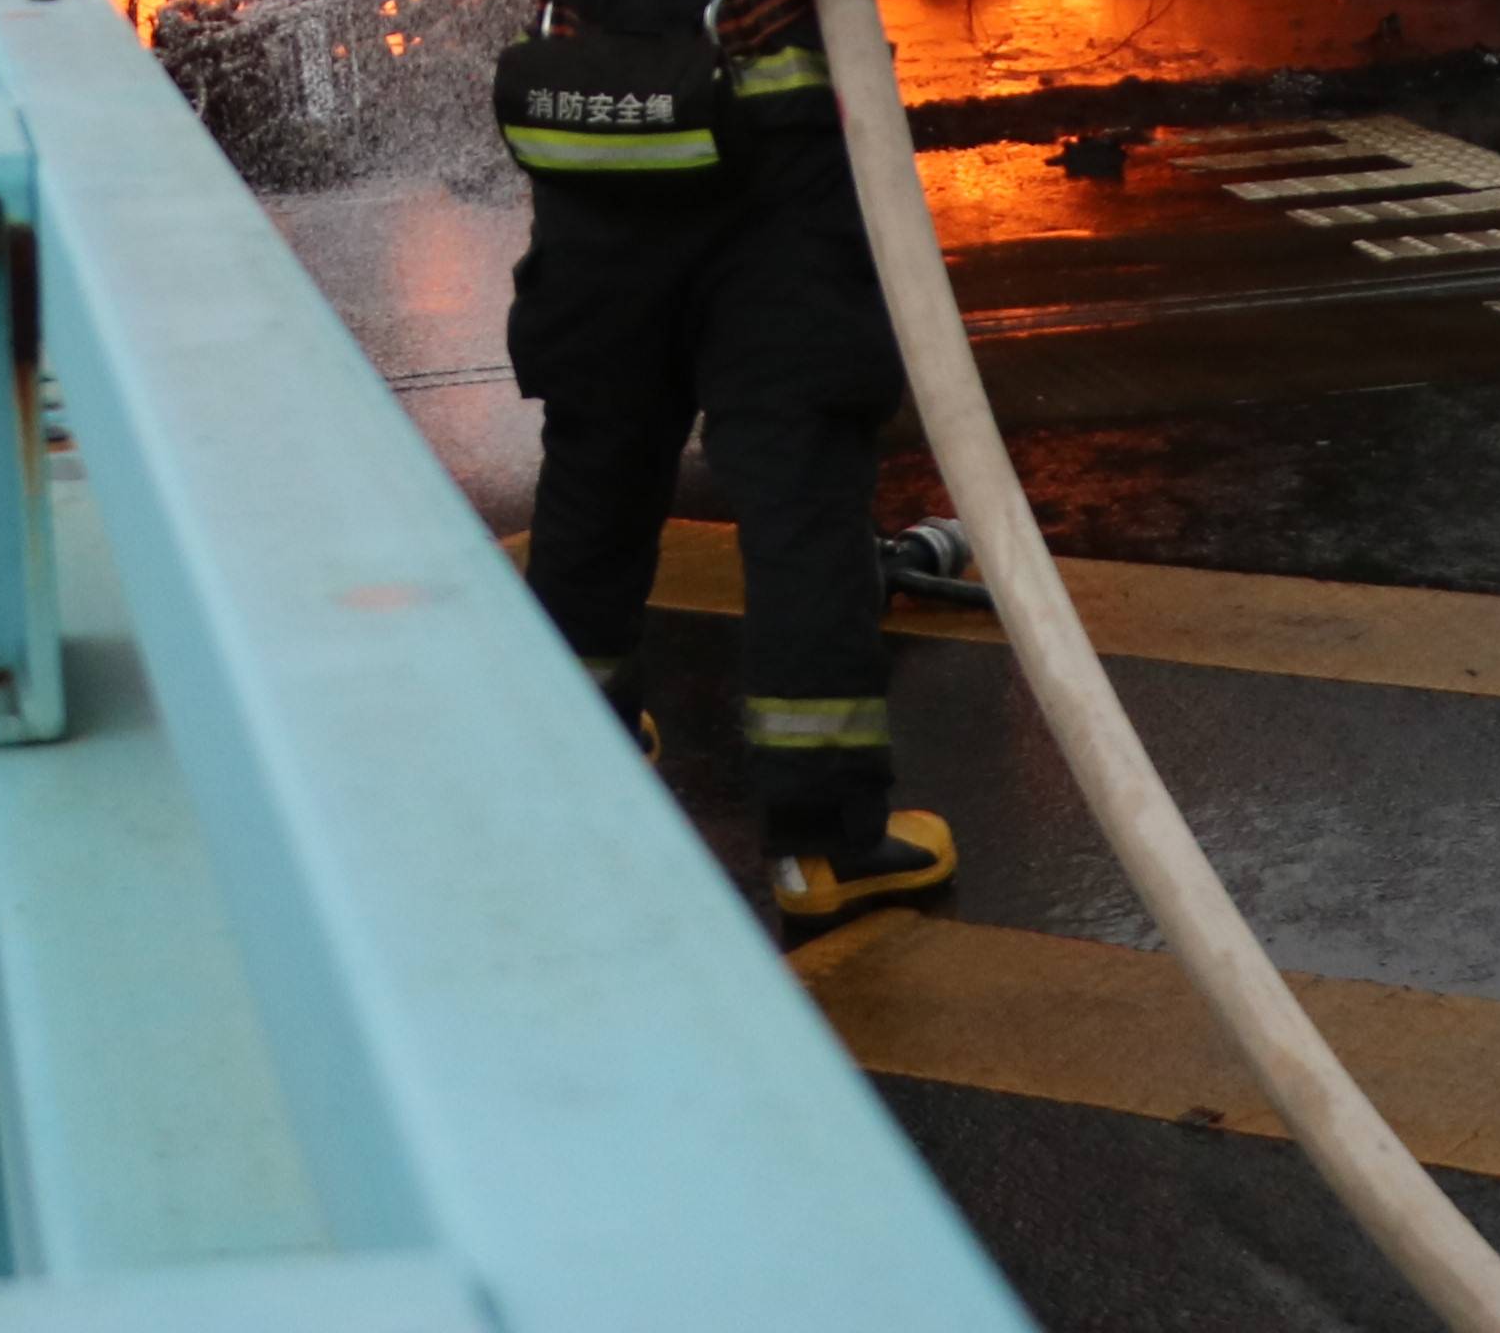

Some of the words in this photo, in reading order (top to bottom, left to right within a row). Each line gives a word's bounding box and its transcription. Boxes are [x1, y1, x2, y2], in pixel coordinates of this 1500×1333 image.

[527, 88, 675, 124] 消防安全绳
